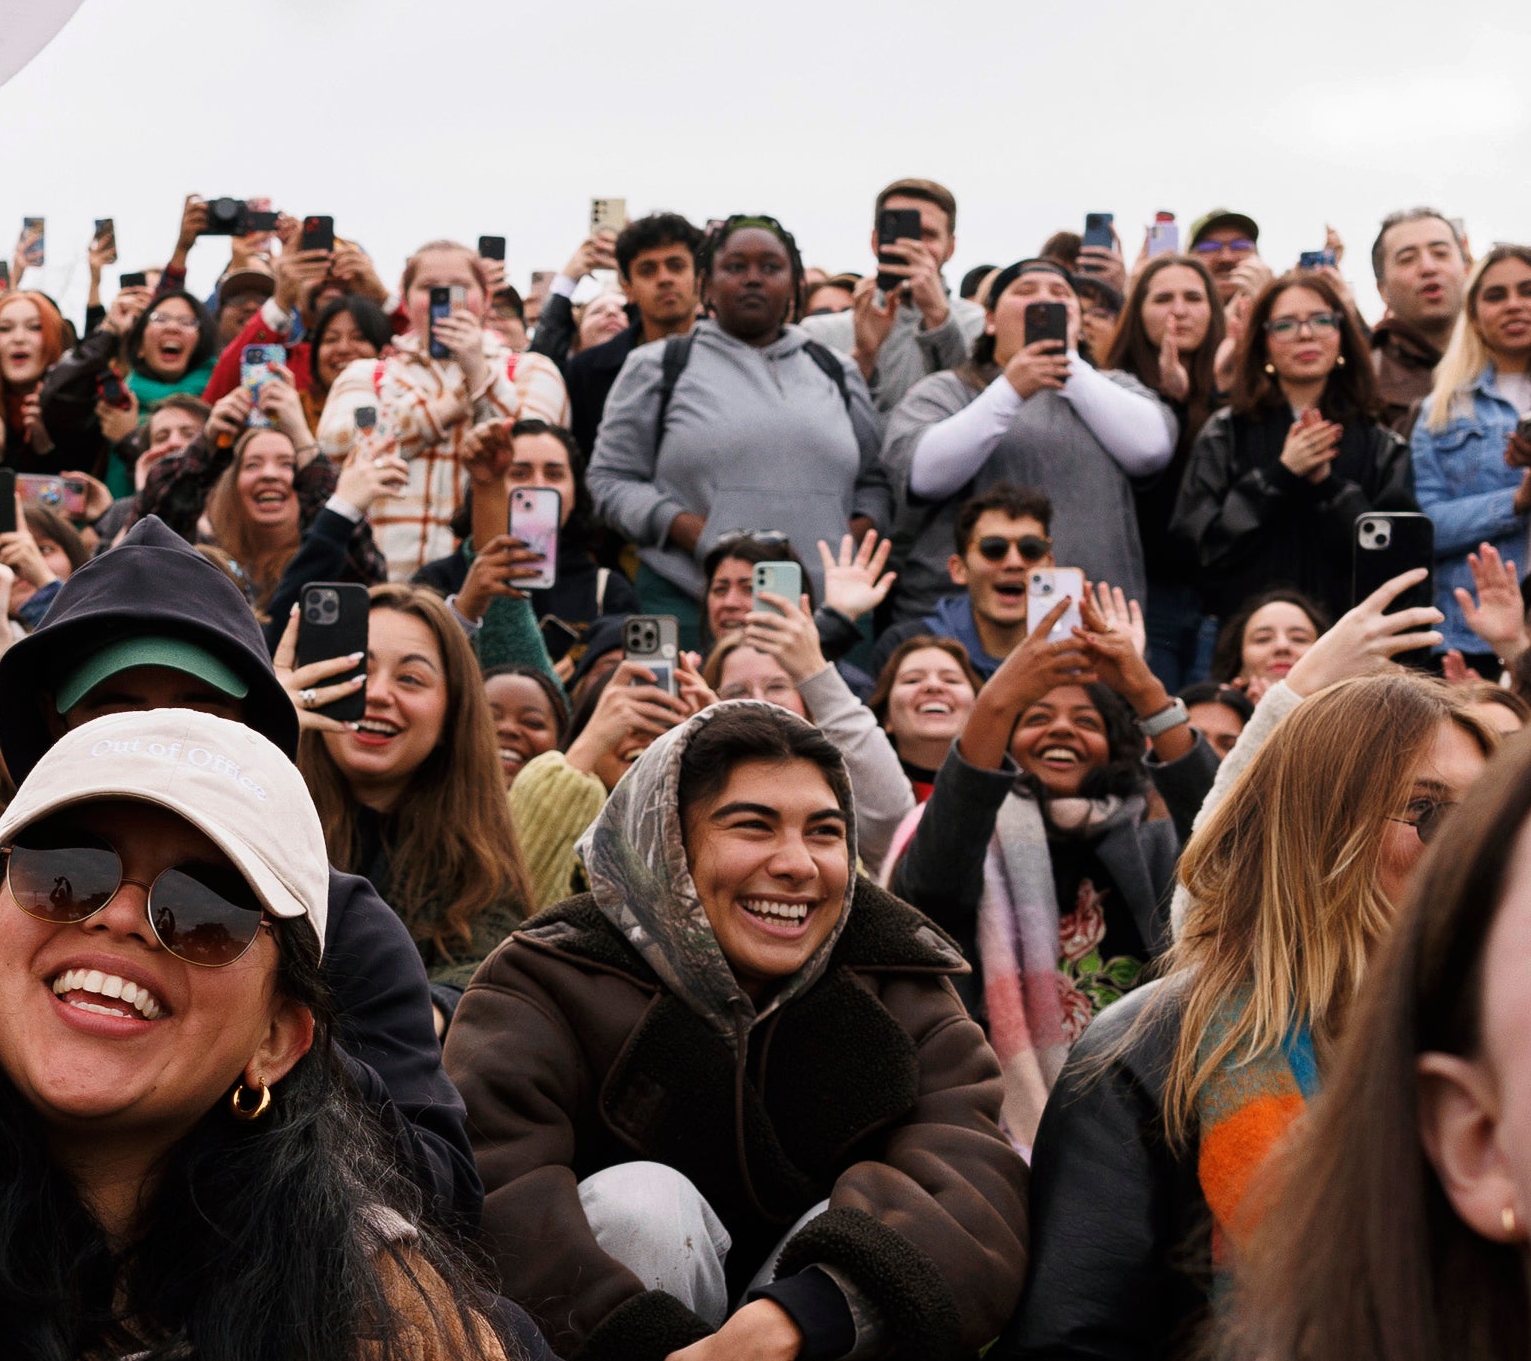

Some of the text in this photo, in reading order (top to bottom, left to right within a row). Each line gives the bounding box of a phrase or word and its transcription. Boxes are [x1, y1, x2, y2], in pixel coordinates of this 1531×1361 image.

[90, 739, 267, 802] Out of Office
